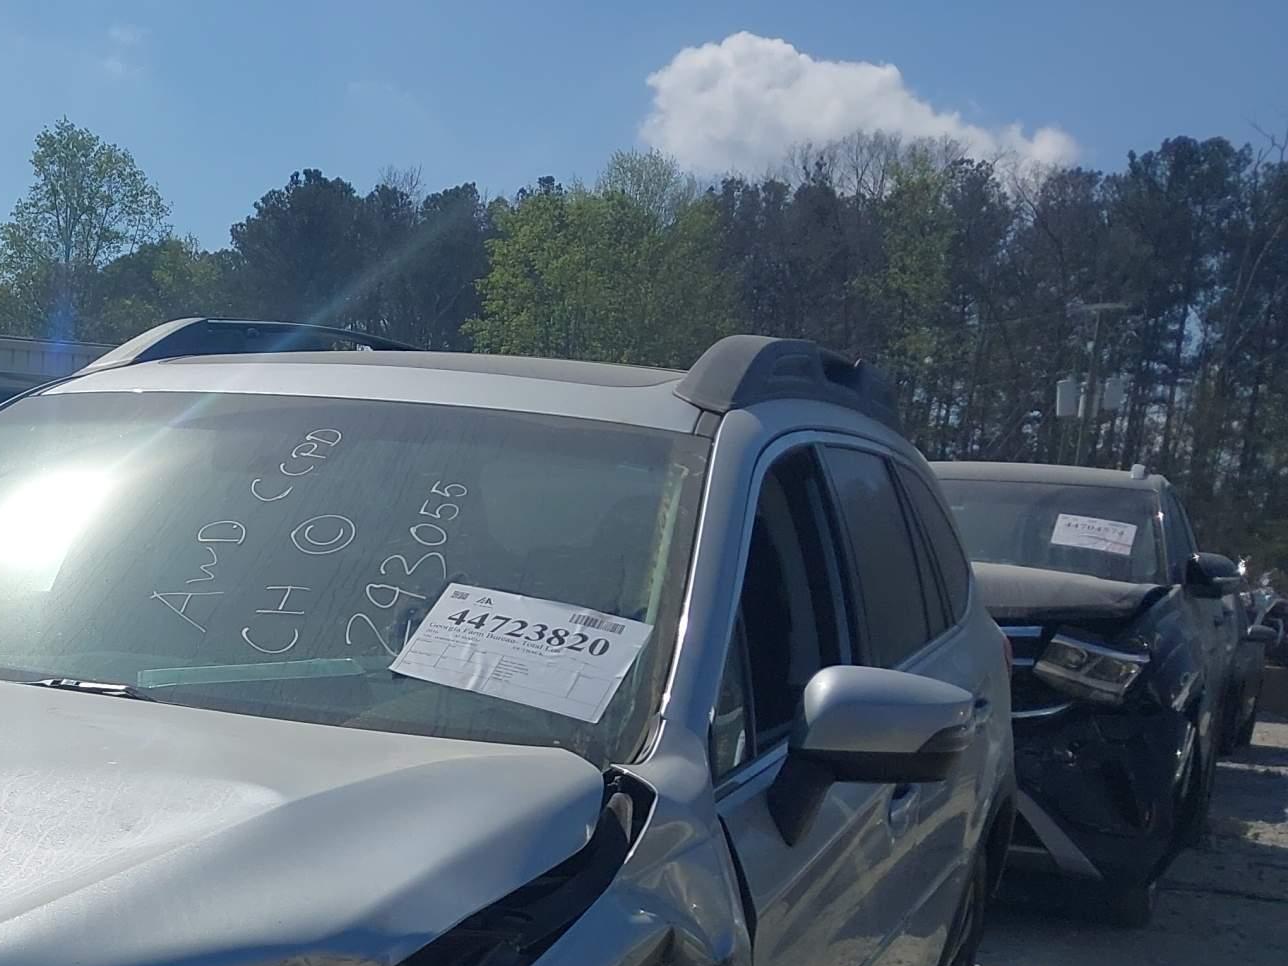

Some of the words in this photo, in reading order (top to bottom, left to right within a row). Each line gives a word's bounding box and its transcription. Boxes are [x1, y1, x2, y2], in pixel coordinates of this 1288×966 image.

[345, 479, 468, 658] 293055
[242, 585, 311, 654] CH
[447, 609, 610, 657] 44723820
